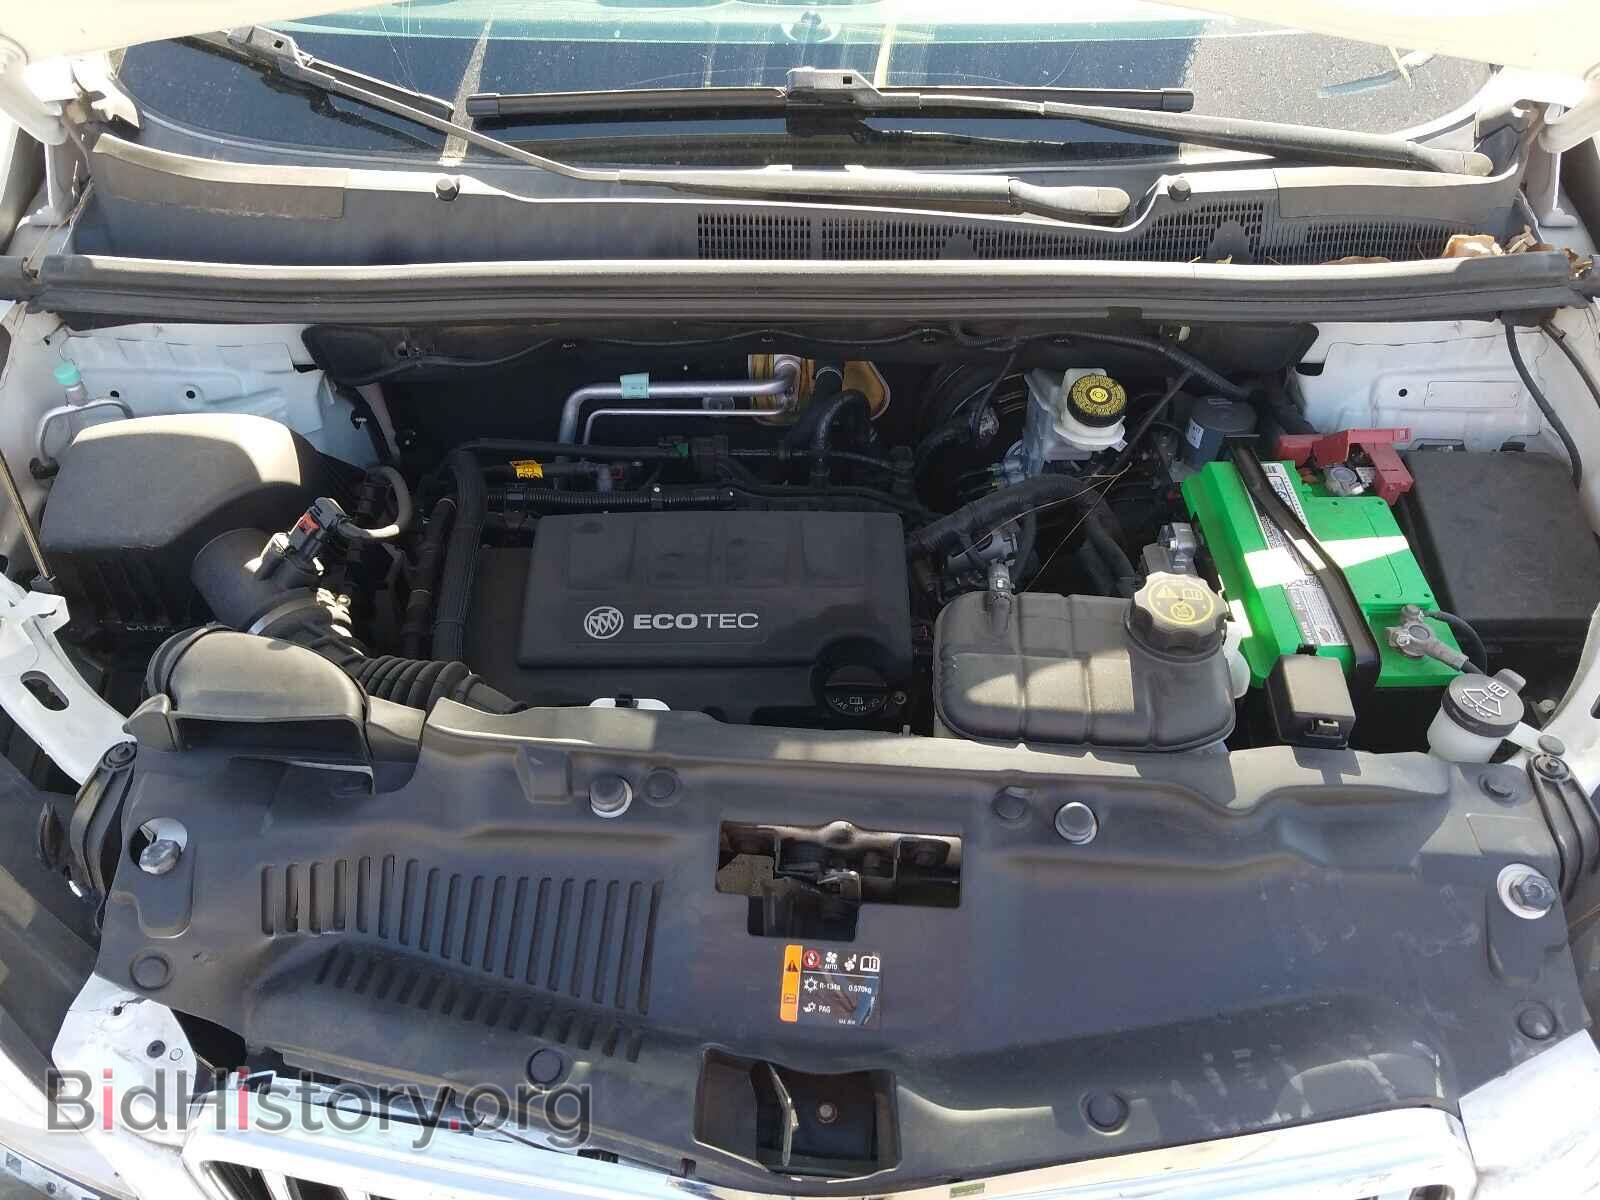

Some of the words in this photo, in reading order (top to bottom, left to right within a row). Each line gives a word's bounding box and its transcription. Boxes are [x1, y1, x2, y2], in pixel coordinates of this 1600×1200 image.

[633, 613, 759, 629] ECOTEC
[848, 985, 872, 994] 0.570kg
[818, 1005, 831, 1014] PAG
